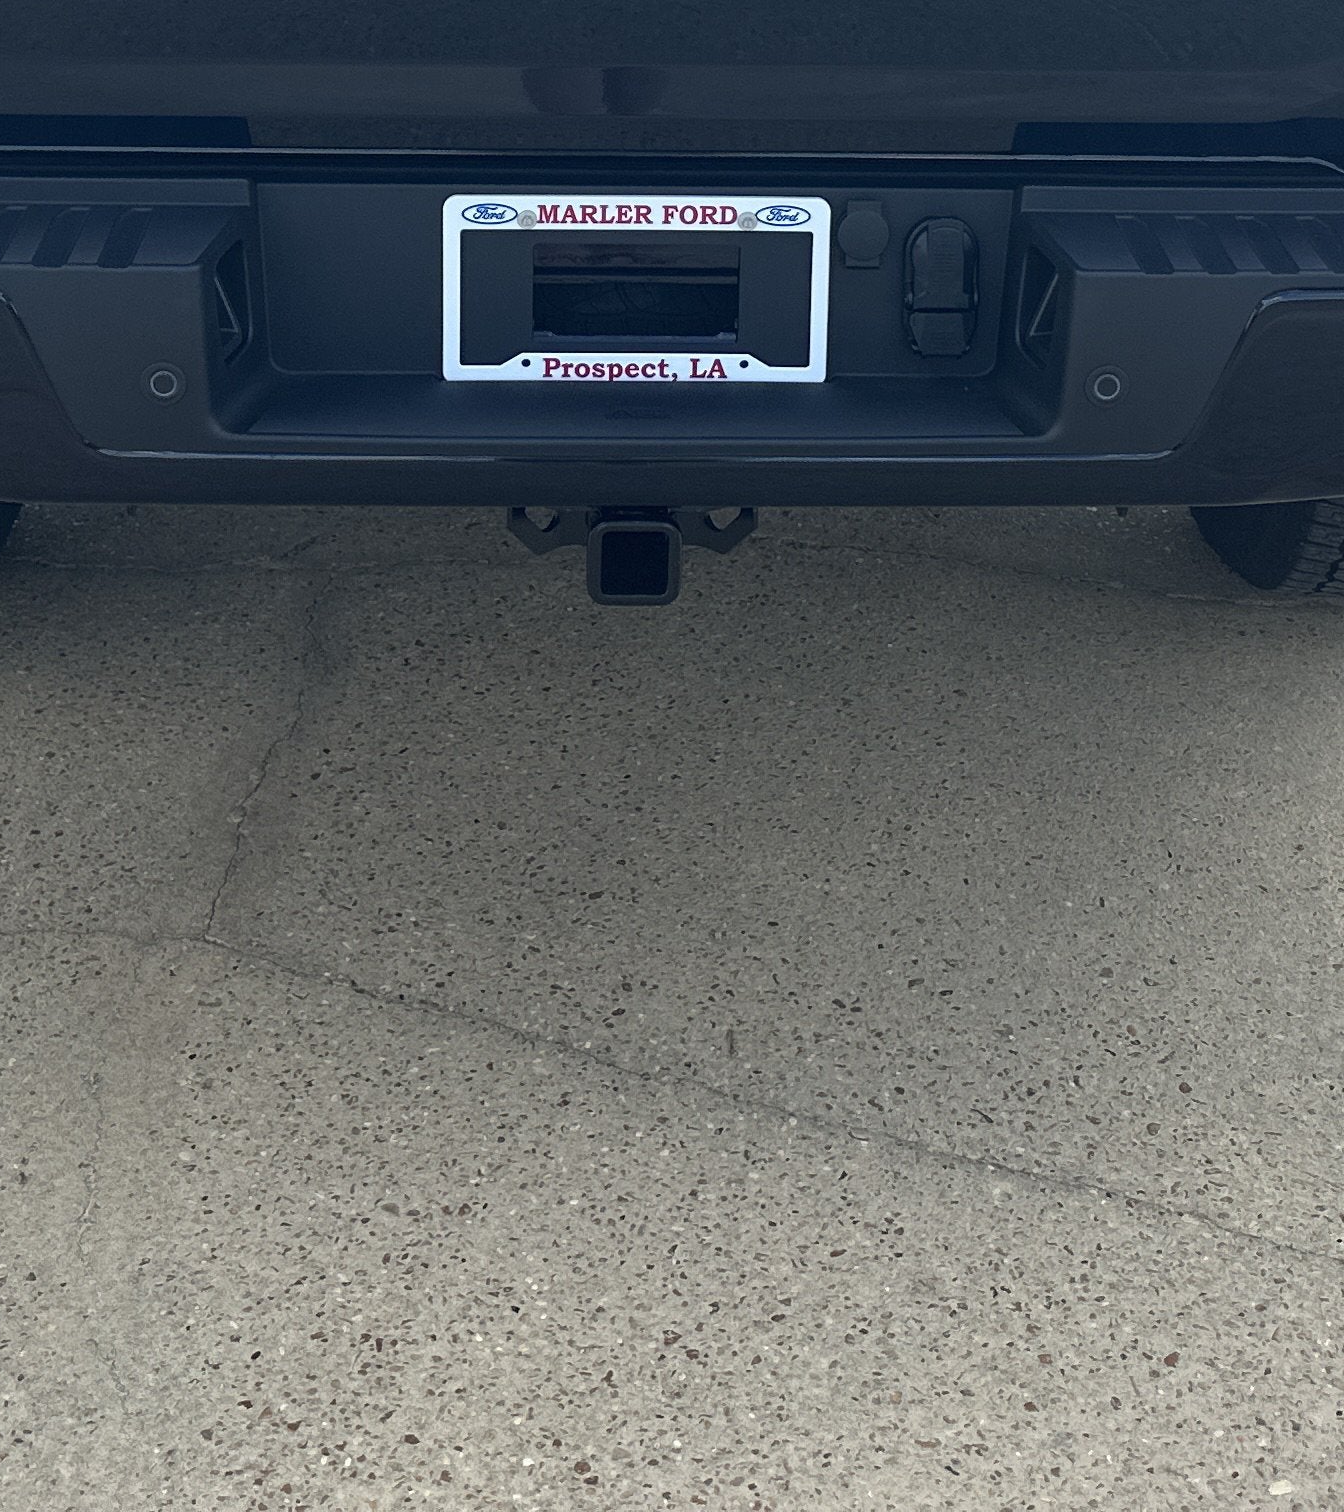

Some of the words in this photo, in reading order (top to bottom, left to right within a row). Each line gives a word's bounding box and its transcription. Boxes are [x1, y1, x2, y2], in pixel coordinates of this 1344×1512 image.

[536, 204, 654, 225] MARLER
[661, 205, 738, 225] FORD
[542, 357, 678, 381] Prospect,
[690, 358, 728, 379] LA
